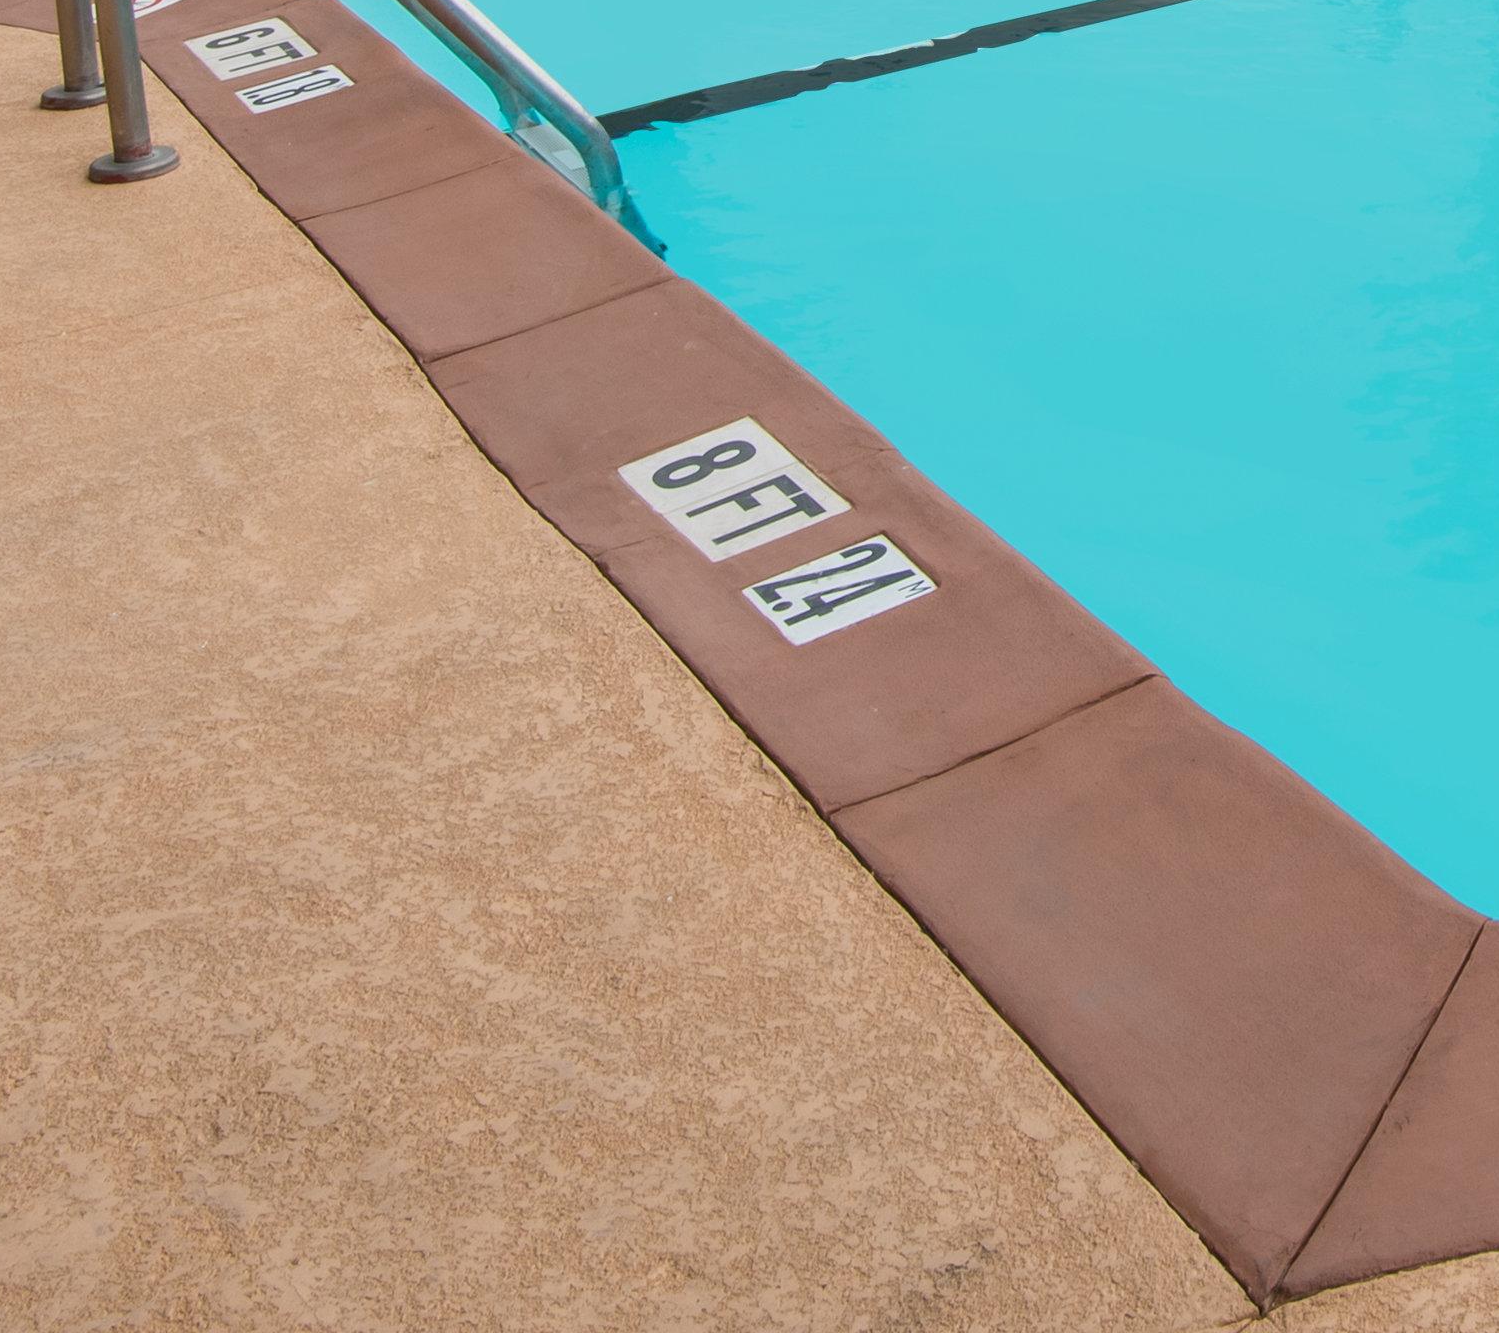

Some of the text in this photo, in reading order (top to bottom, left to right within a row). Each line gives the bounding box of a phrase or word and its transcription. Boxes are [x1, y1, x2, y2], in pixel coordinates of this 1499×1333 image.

[205, 27, 304, 73] 6 FT
[652, 440, 827, 546] 8 FT
